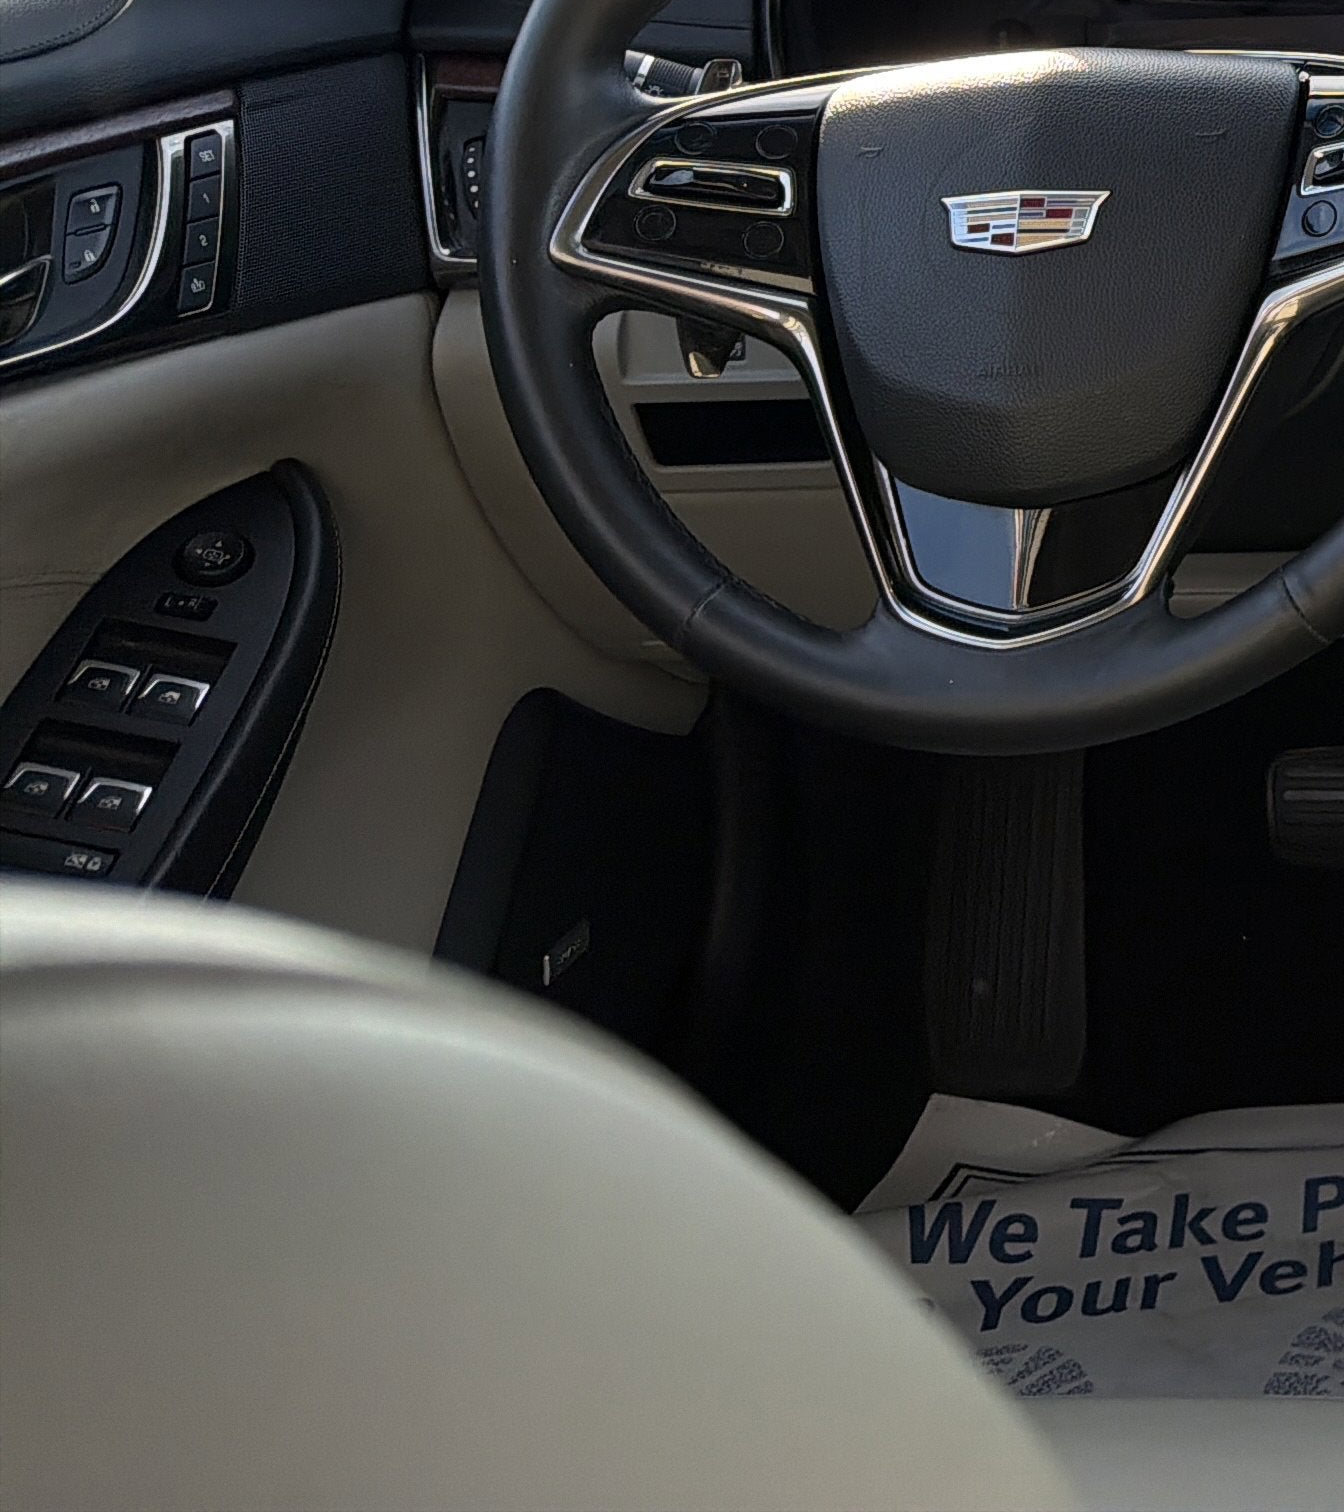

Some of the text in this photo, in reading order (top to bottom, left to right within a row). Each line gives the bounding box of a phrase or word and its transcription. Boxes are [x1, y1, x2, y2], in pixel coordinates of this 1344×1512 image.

[199, 234, 208, 246] 2
[908, 1197, 1039, 1265] We
[1069, 1193, 1269, 1259] Take
[969, 1270, 1177, 1333] Your
